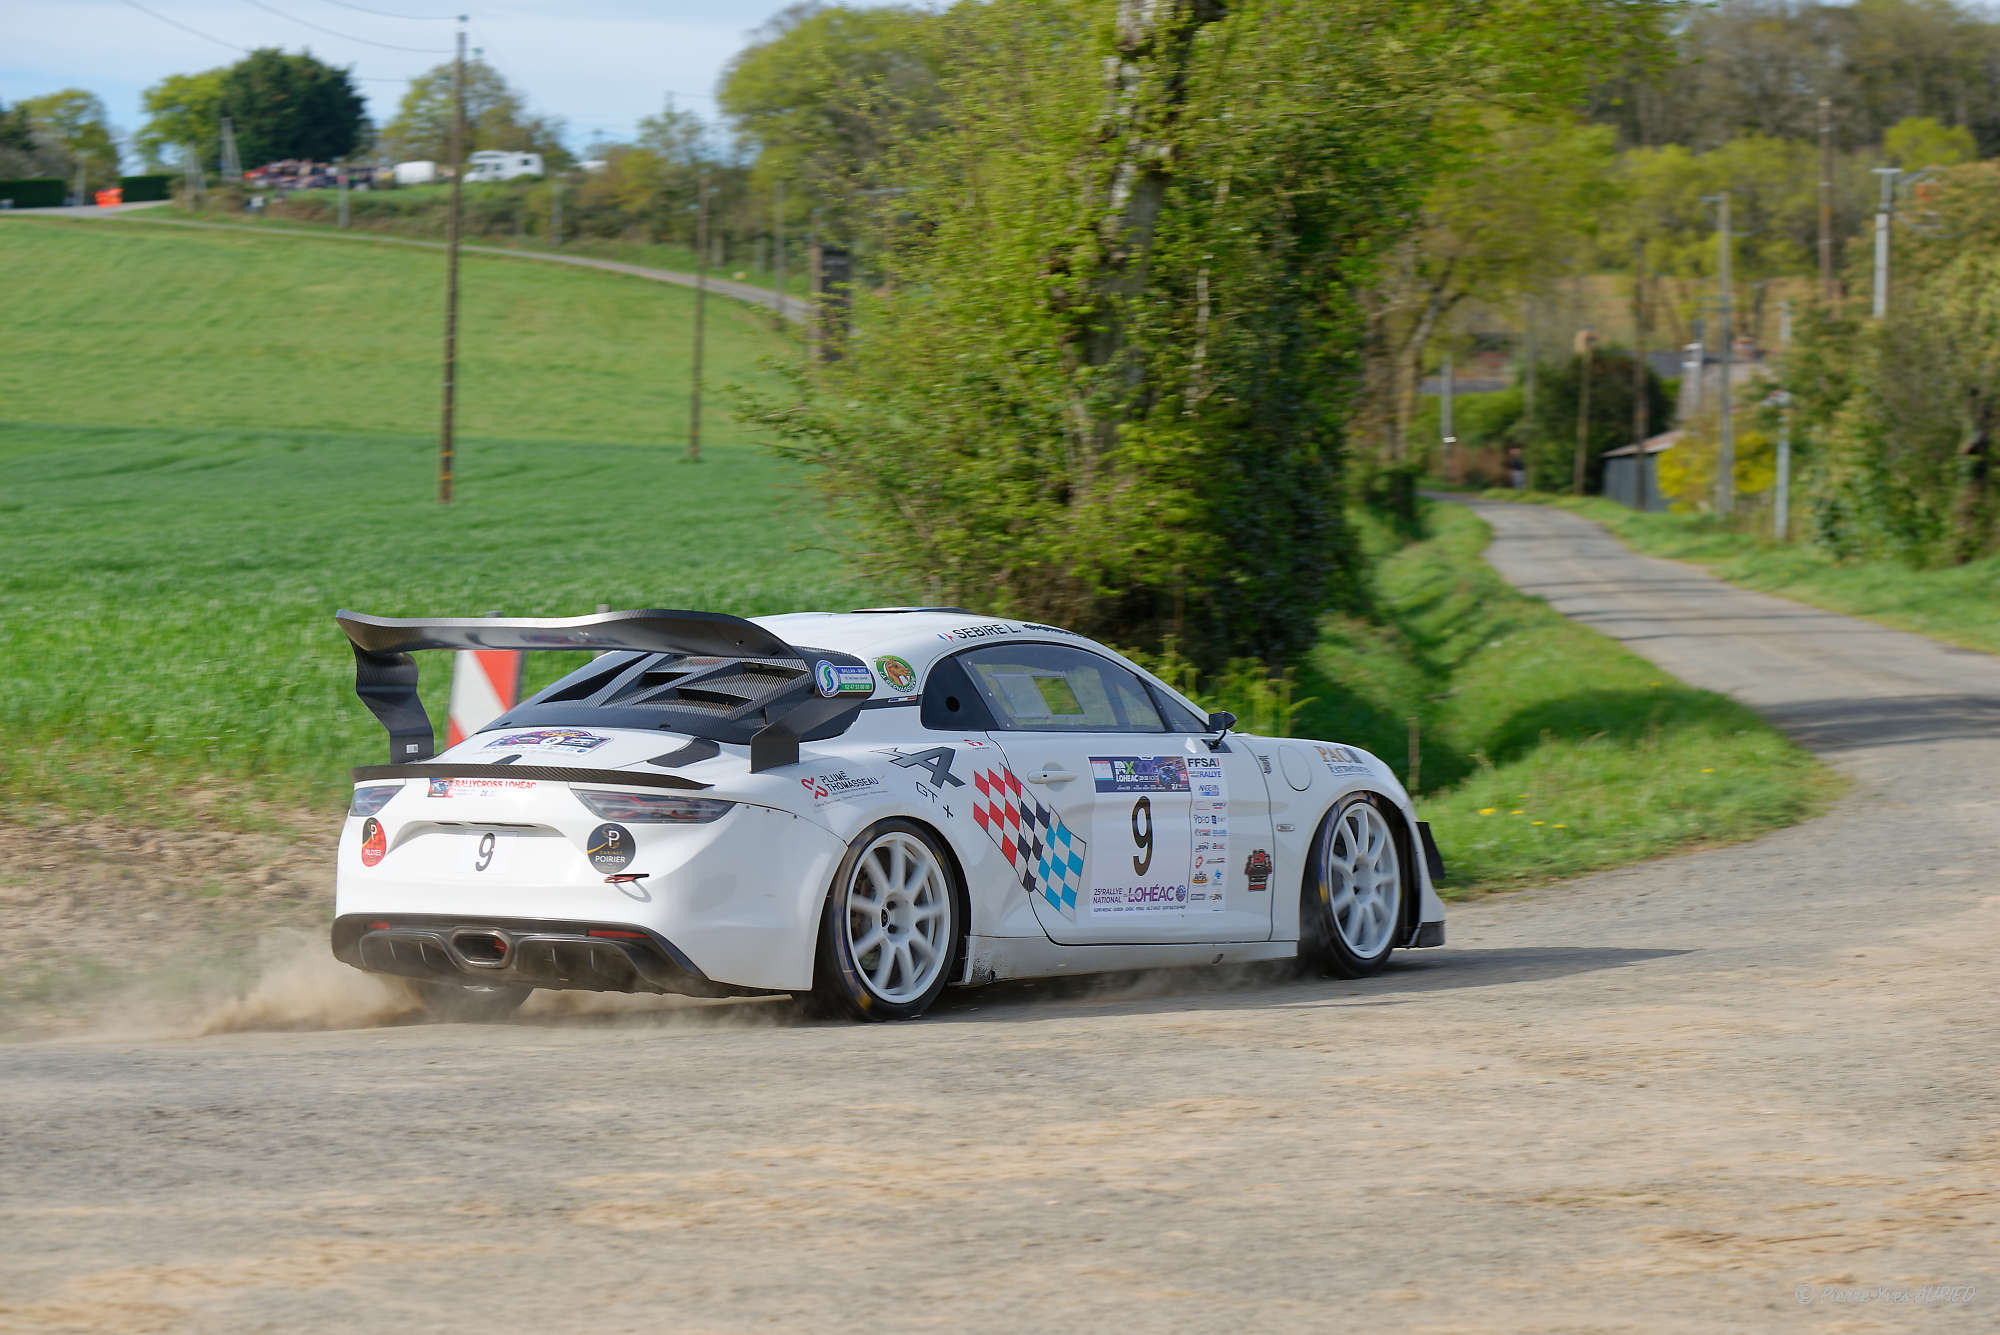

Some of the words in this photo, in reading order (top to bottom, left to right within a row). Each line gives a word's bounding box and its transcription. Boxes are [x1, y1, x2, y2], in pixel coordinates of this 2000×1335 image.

[952, 624, 1006, 639] SEBIRE
[1004, 624, 1021, 633] L.
[1187, 757, 1217, 768] FFSA
[1199, 770, 1222, 778] RALLYE
[455, 779, 503, 788] RALLYCROSS
[825, 776, 880, 792] THOMASSEAU
[1131, 795, 1154, 877] 9
[475, 832, 496, 872] 9
[595, 855, 626, 864] POIRIER
[1127, 884, 1175, 902] LOHÉAC
[1093, 896, 1122, 904] NATIONAL
